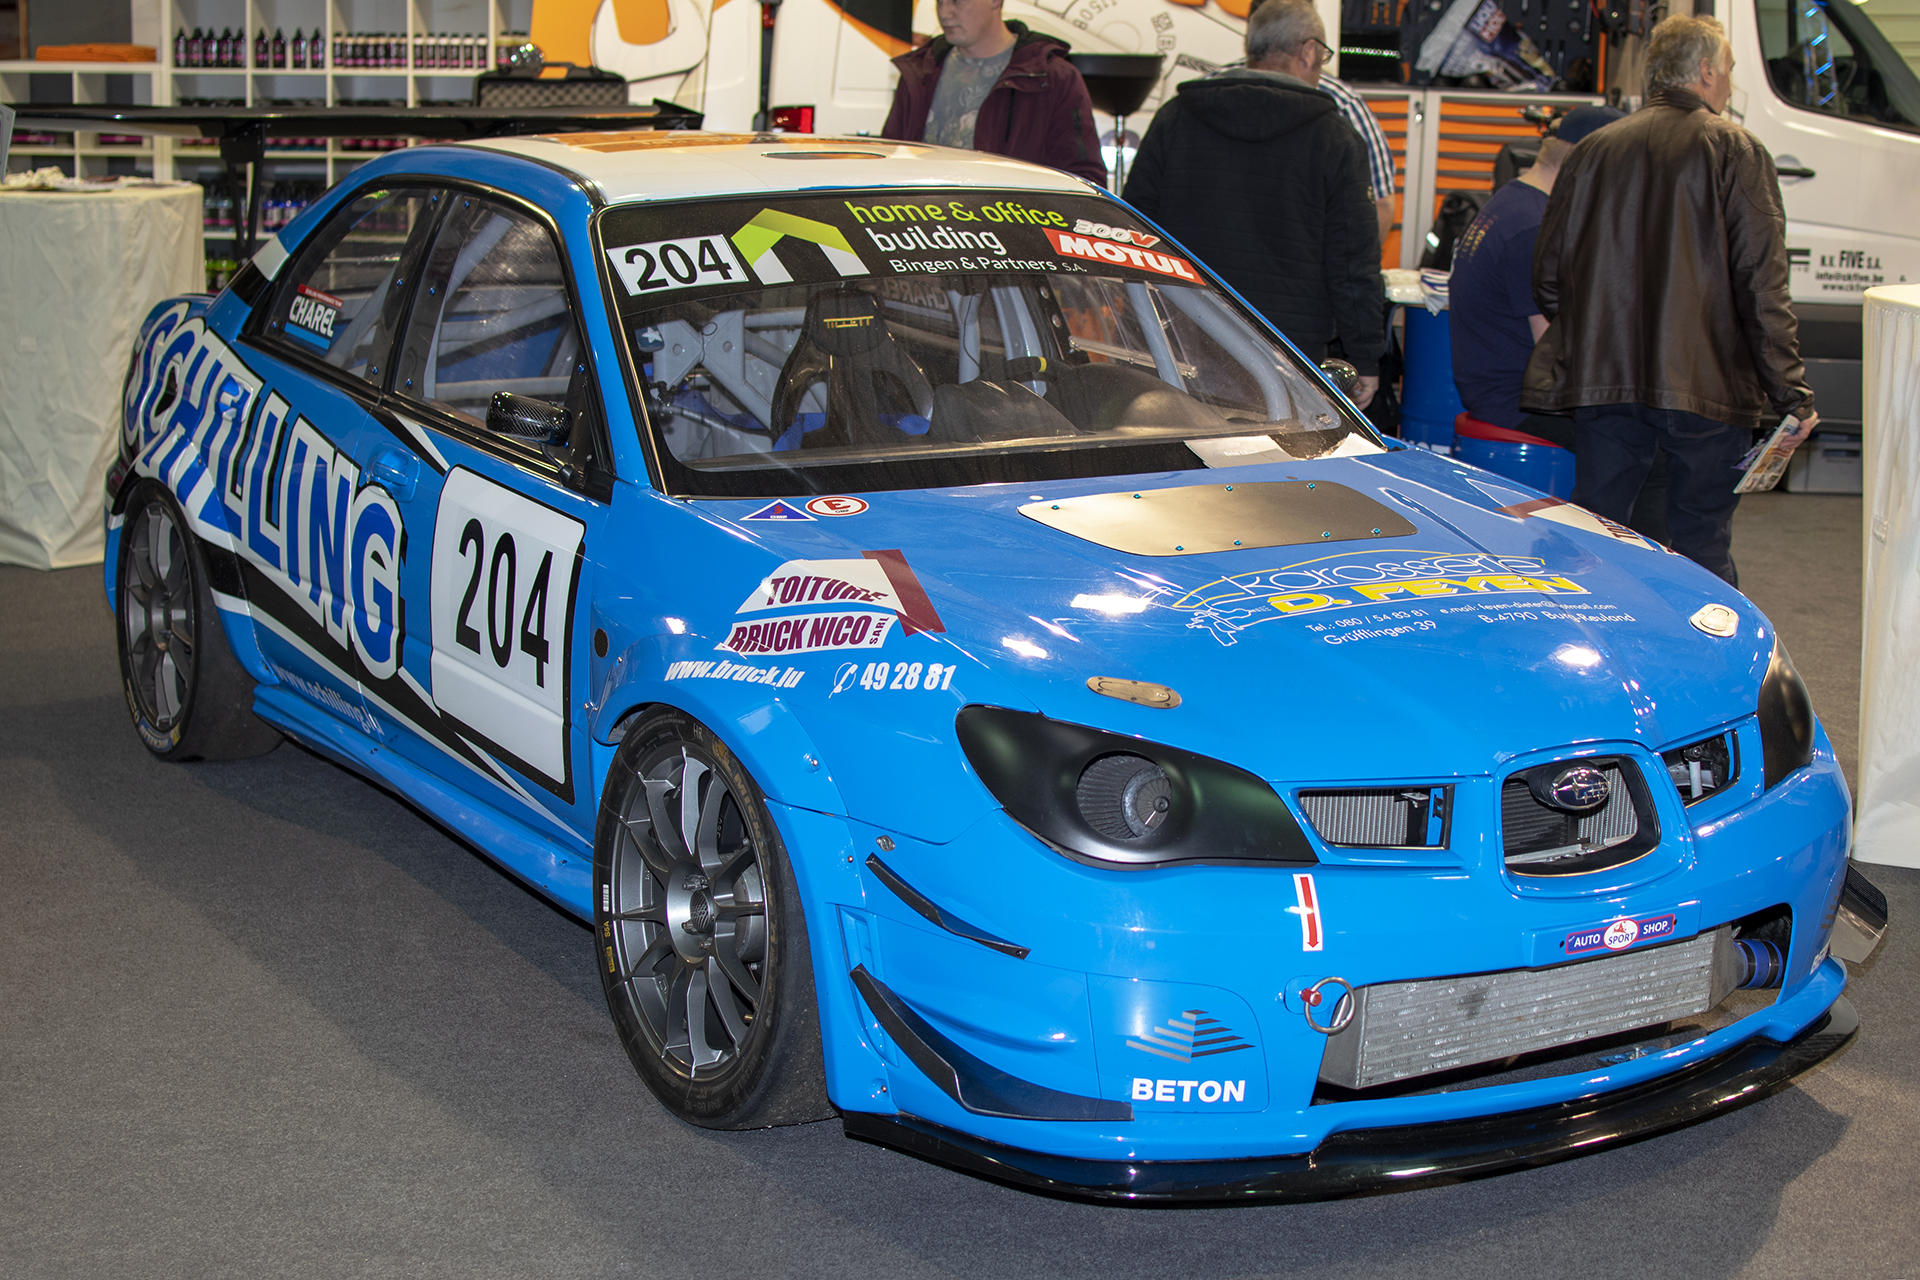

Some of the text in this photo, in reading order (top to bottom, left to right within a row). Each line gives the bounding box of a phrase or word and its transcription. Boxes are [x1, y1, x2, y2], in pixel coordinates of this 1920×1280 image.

[844, 201, 1069, 228] home & office
[866, 226, 1008, 255] building
[1073, 219, 1160, 248] 300V
[625, 239, 732, 291] 204
[889, 256, 1088, 273] Bingen & Partners S.A.
[1059, 233, 1195, 279] MOTUL
[1840, 250, 1864, 269] FIVE
[289, 295, 336, 338] CHAREL
[823, 315, 874, 329] TILLETT
[118, 301, 403, 681] SCHILLING
[822, 499, 851, 511] E
[456, 517, 553, 689] 204
[766, 575, 889, 606] TOITURE
[1266, 574, 1591, 614] D. FEYEN
[1305, 609, 1429, 633] Tel.: 080 / 54 83 81
[1478, 610, 1637, 623] B-4790 Burg-Reuland
[724, 615, 872, 653] BRUCK NICO
[869, 617, 889, 645] SARL
[1323, 620, 1437, 645] Grüfflingen 39
[664, 660, 805, 688] www.bruck.lu
[860, 662, 957, 690] 49 28 81
[271, 663, 385, 736] www.schilling.lu
[1574, 934, 1601, 948] AUTO
[1608, 932, 1635, 946] SPORT
[1643, 921, 1668, 935] SHOP
[1131, 1078, 1246, 1103] BETON
